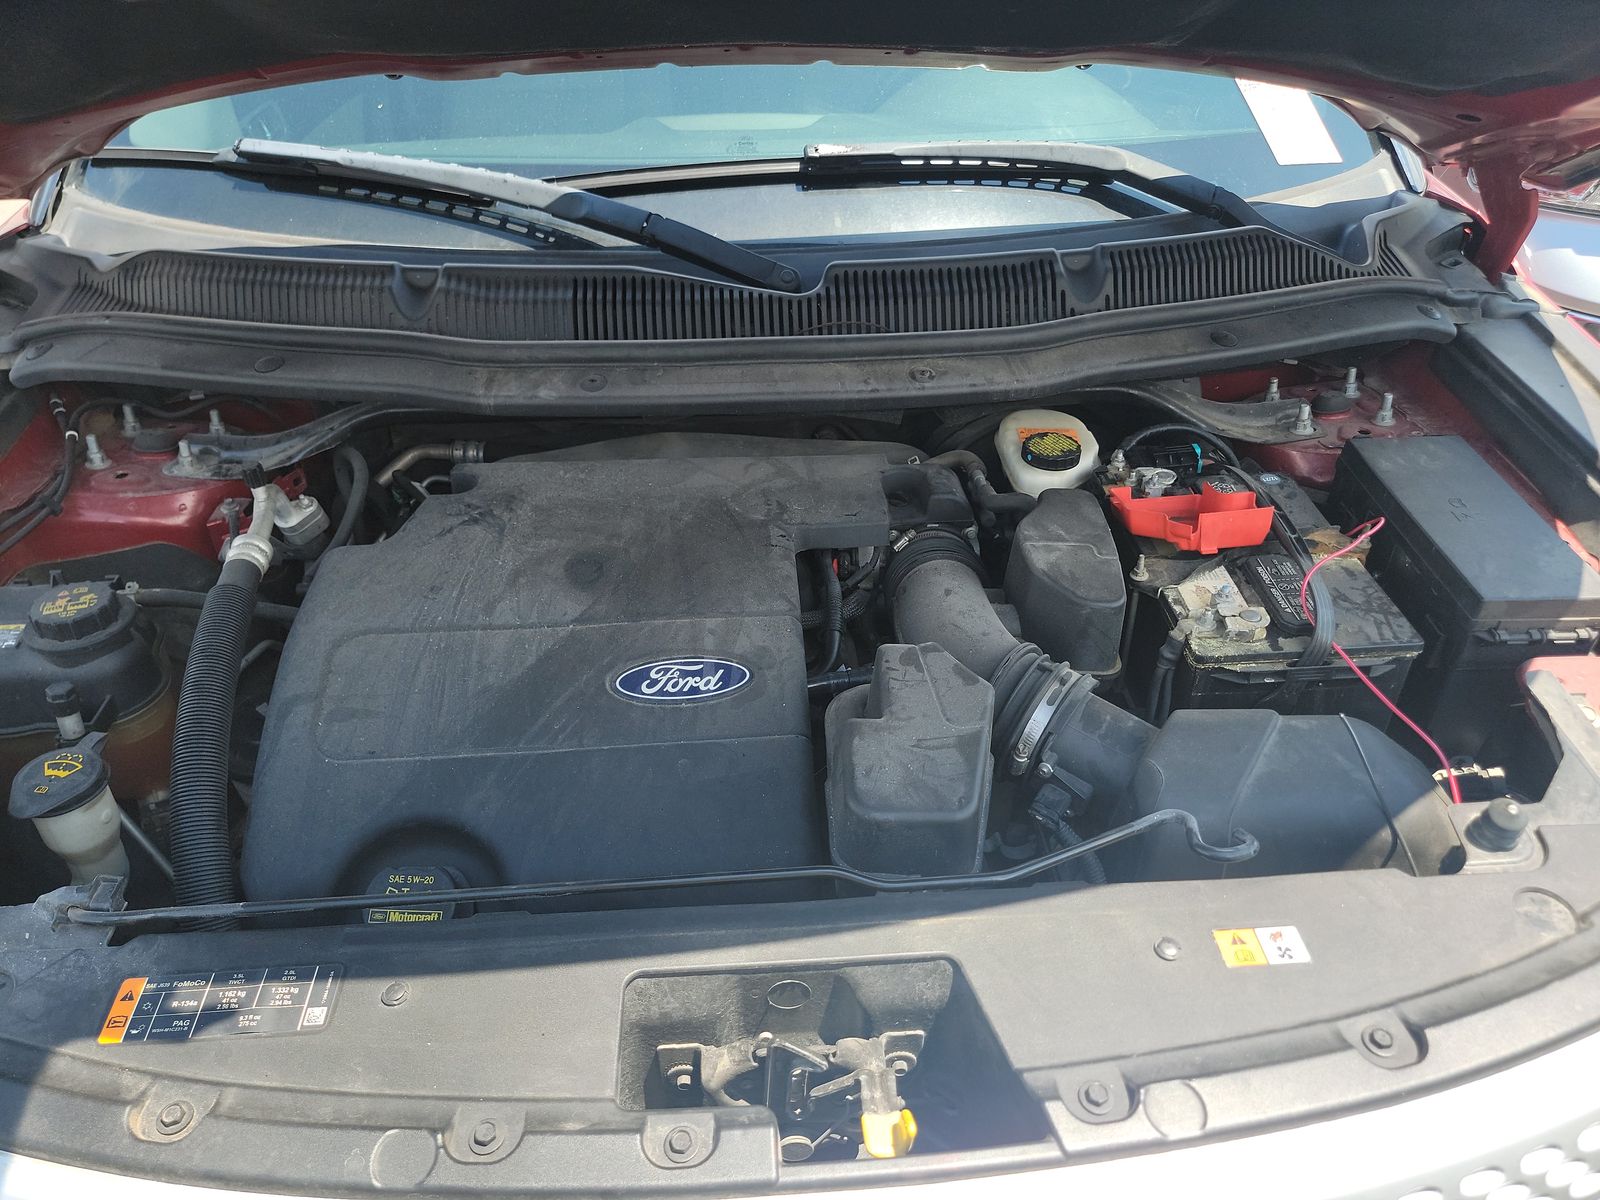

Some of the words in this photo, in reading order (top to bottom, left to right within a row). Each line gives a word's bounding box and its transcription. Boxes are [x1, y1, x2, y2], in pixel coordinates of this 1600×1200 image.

[641, 664, 724, 694] Ford
[388, 874, 406, 884] SAE
[406, 875, 435, 885] 5W-20
[388, 911, 439, 923] Motorcraft
[173, 980, 206, 988] FoMoCo
[237, 990, 247, 998] kg
[290, 986, 299, 994] kg
[171, 1000, 199, 1008] R-134a
[172, 1019, 190, 1027] PAG
